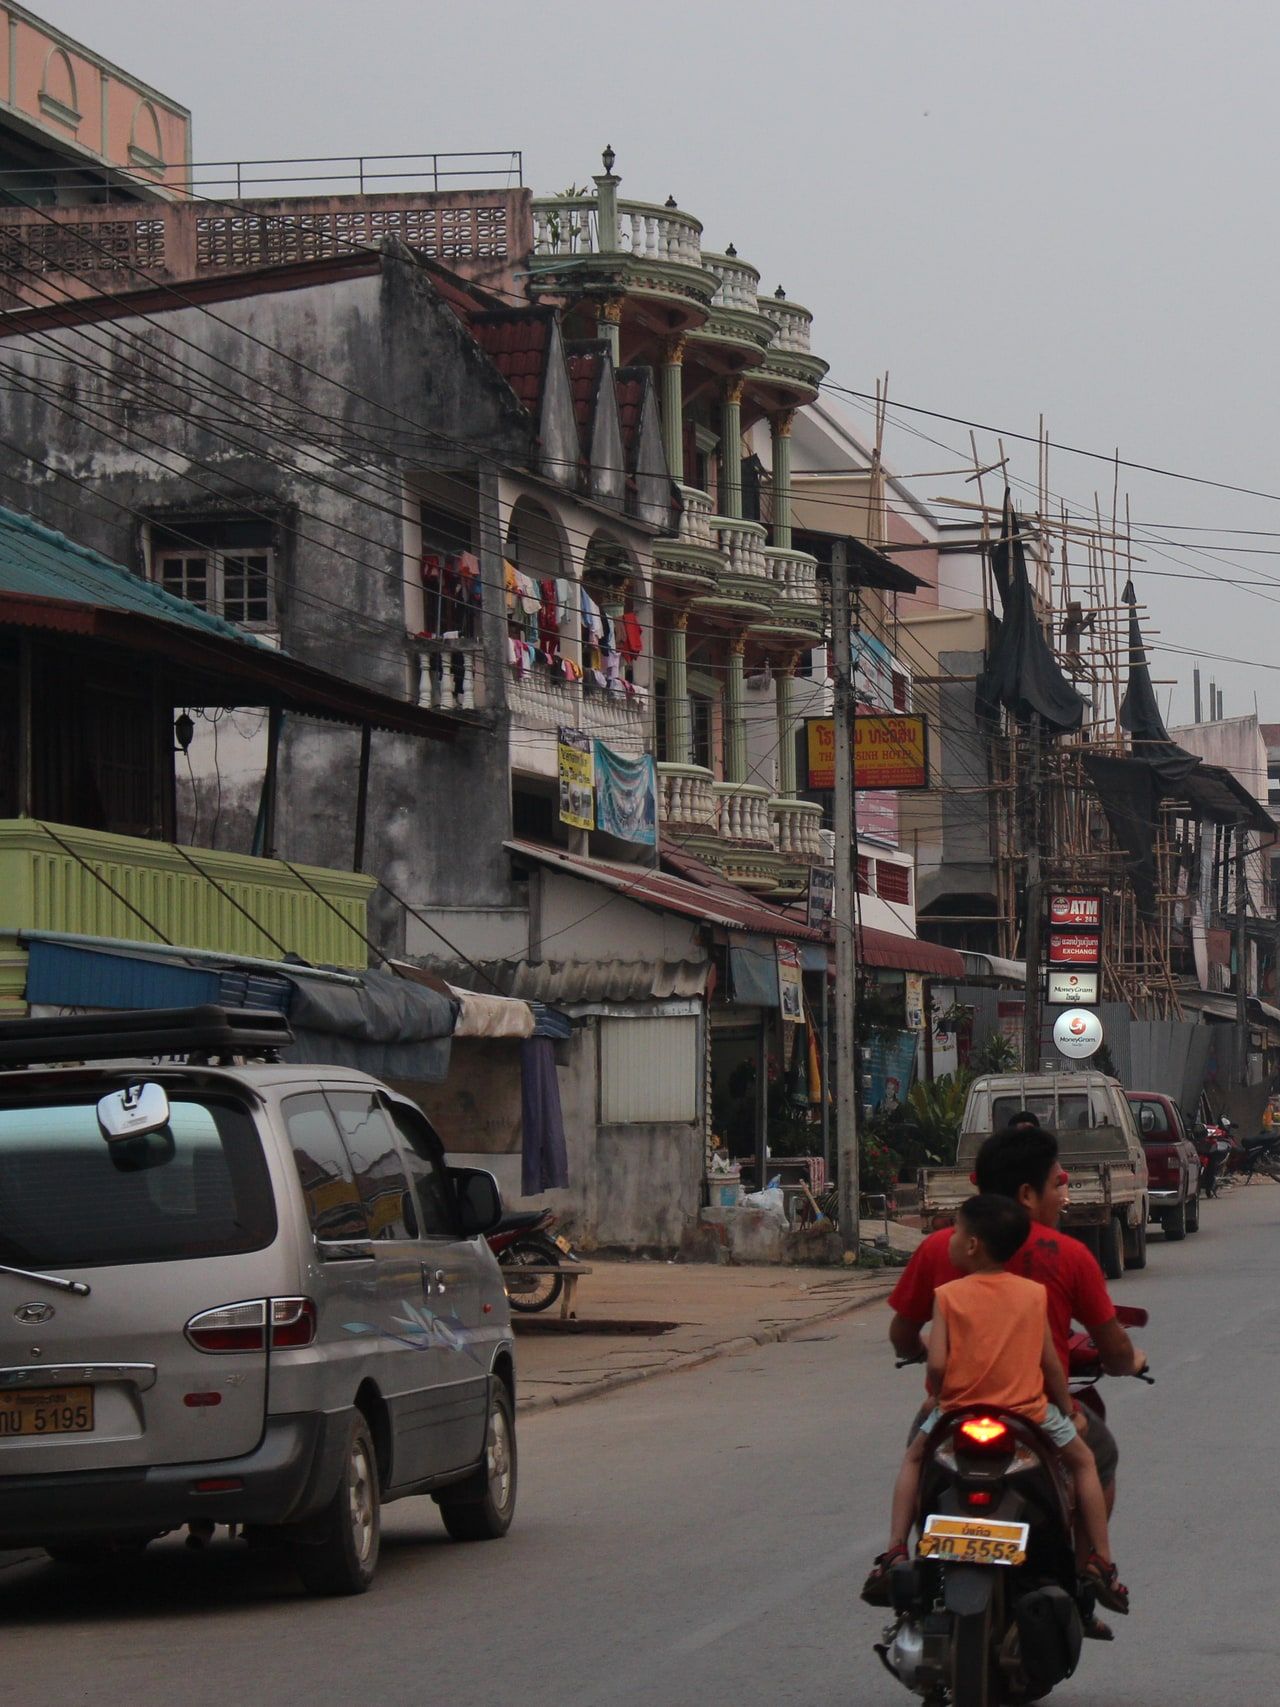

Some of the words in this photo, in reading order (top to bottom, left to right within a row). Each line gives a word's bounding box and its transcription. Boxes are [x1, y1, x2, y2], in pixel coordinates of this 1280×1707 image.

[883, 750, 912, 761] HOTEL
[1070, 900, 1098, 915] ATM
[1054, 986, 1093, 994] MoneyGram
[1060, 1036, 1096, 1044] MoneyGram
[34, 1406, 88, 1431] 5195
